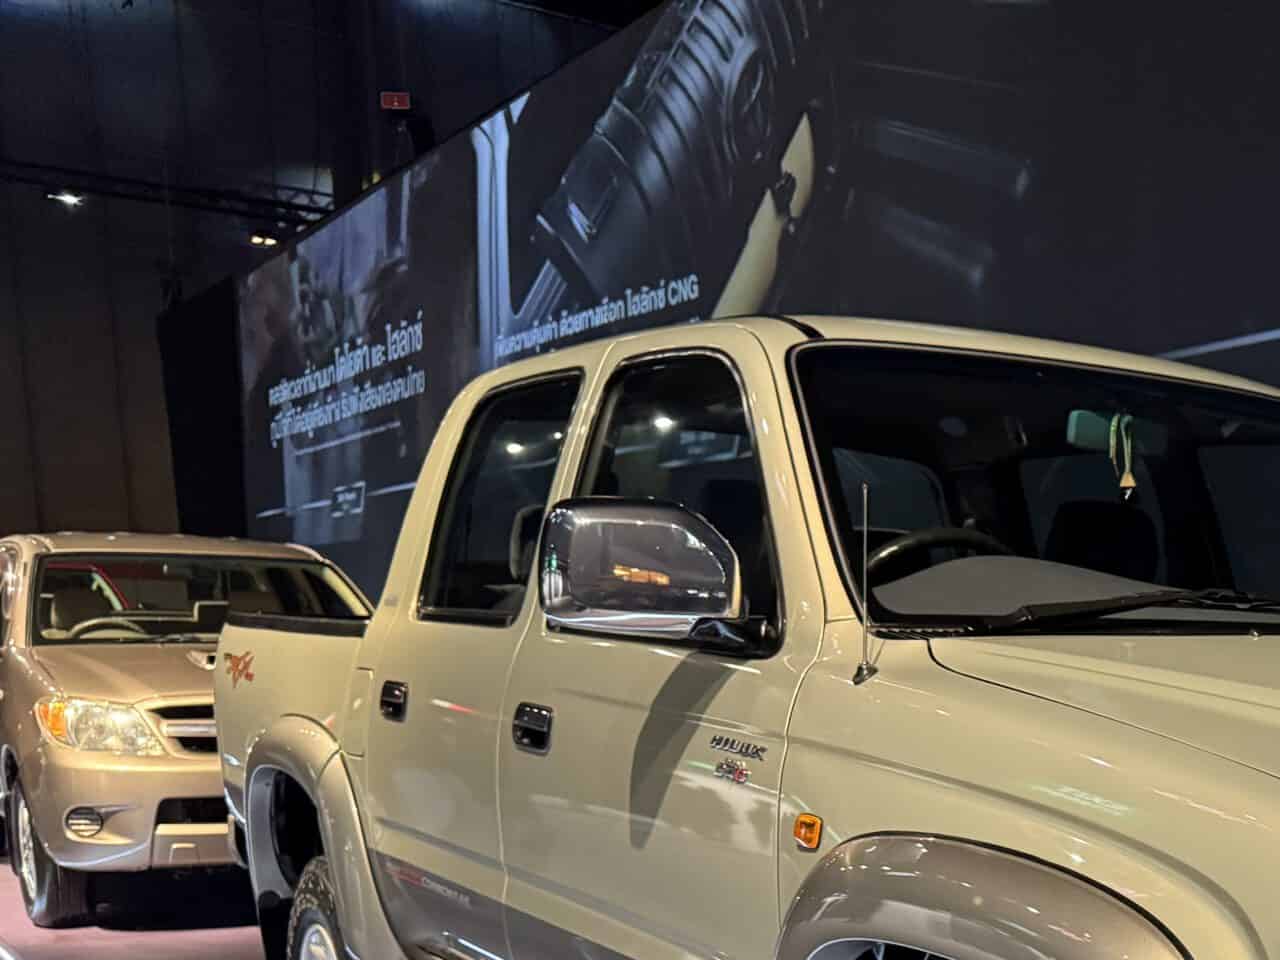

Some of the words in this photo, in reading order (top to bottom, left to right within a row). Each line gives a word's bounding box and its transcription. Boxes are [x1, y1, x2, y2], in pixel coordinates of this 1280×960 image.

[667, 274, 699, 305] CNG
[385, 309, 424, 363] ไฮลักซ์
